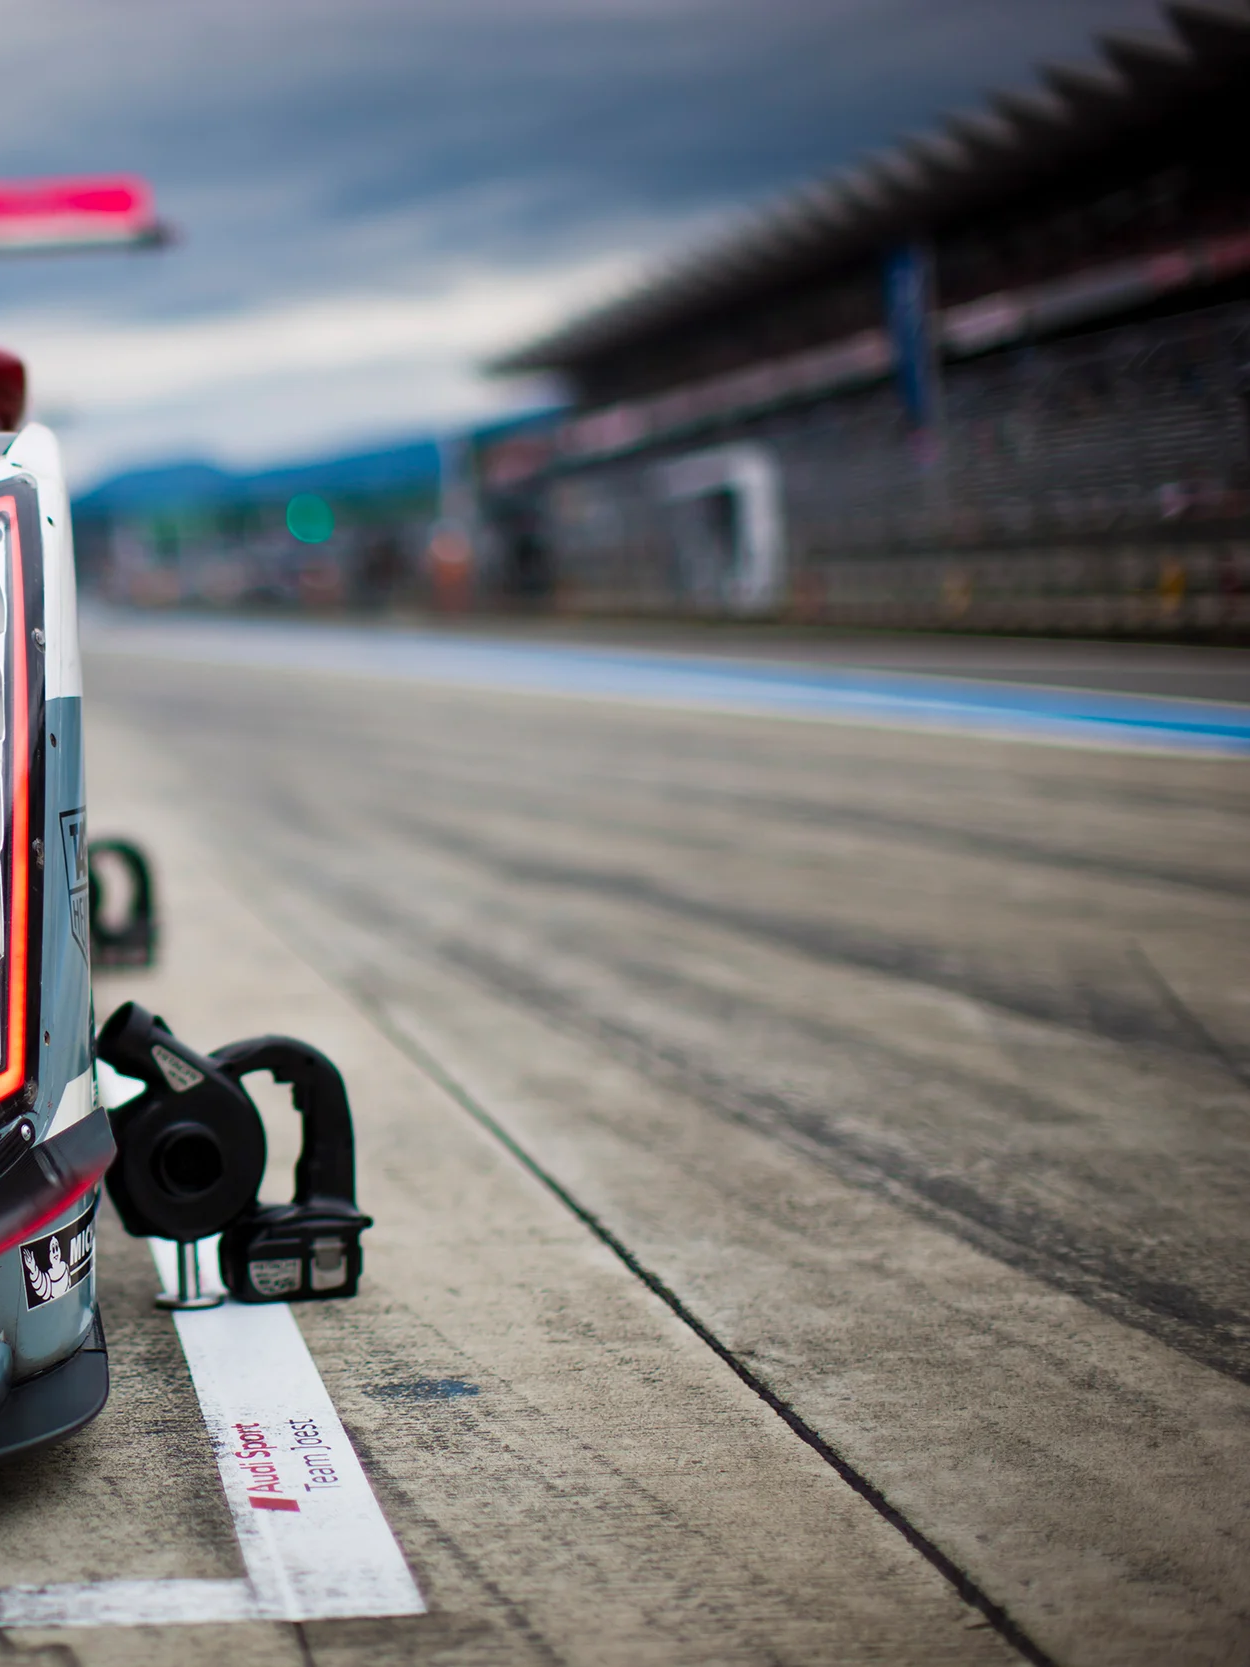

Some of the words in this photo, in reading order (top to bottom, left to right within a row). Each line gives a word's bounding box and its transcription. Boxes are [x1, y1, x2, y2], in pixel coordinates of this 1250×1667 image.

[231, 1422, 278, 1459] Sport
[286, 1418, 332, 1451] Joest
[239, 1461, 284, 1493] Audi
[303, 1453, 342, 1492] Team
